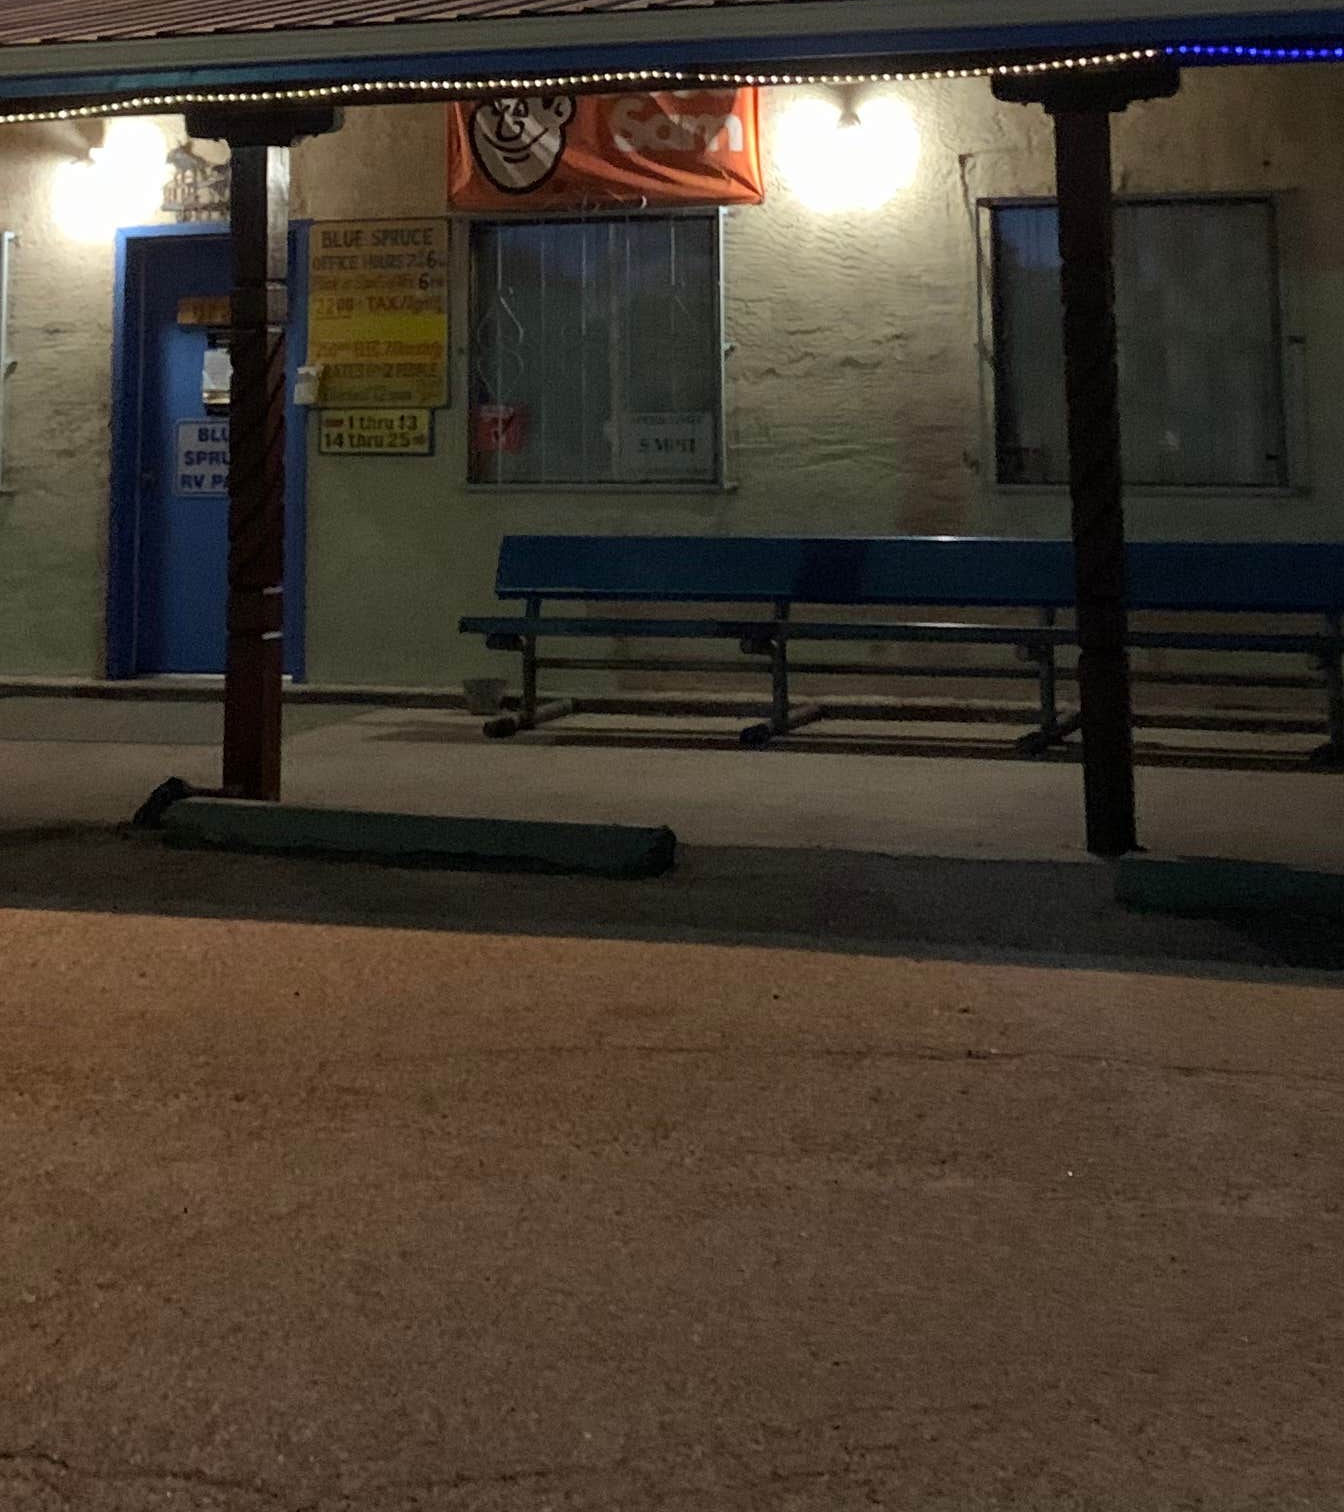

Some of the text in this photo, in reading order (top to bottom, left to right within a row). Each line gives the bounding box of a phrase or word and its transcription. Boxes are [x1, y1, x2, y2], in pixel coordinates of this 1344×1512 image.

[610, 98, 744, 153] Sam
[321, 228, 434, 248] BLUE SPRUCE
[312, 255, 359, 270] OFFICE
[359, 416, 394, 430] thru
[399, 414, 418, 431] 13
[325, 432, 411, 448] 14 thru 25
[181, 474, 205, 489] RV
